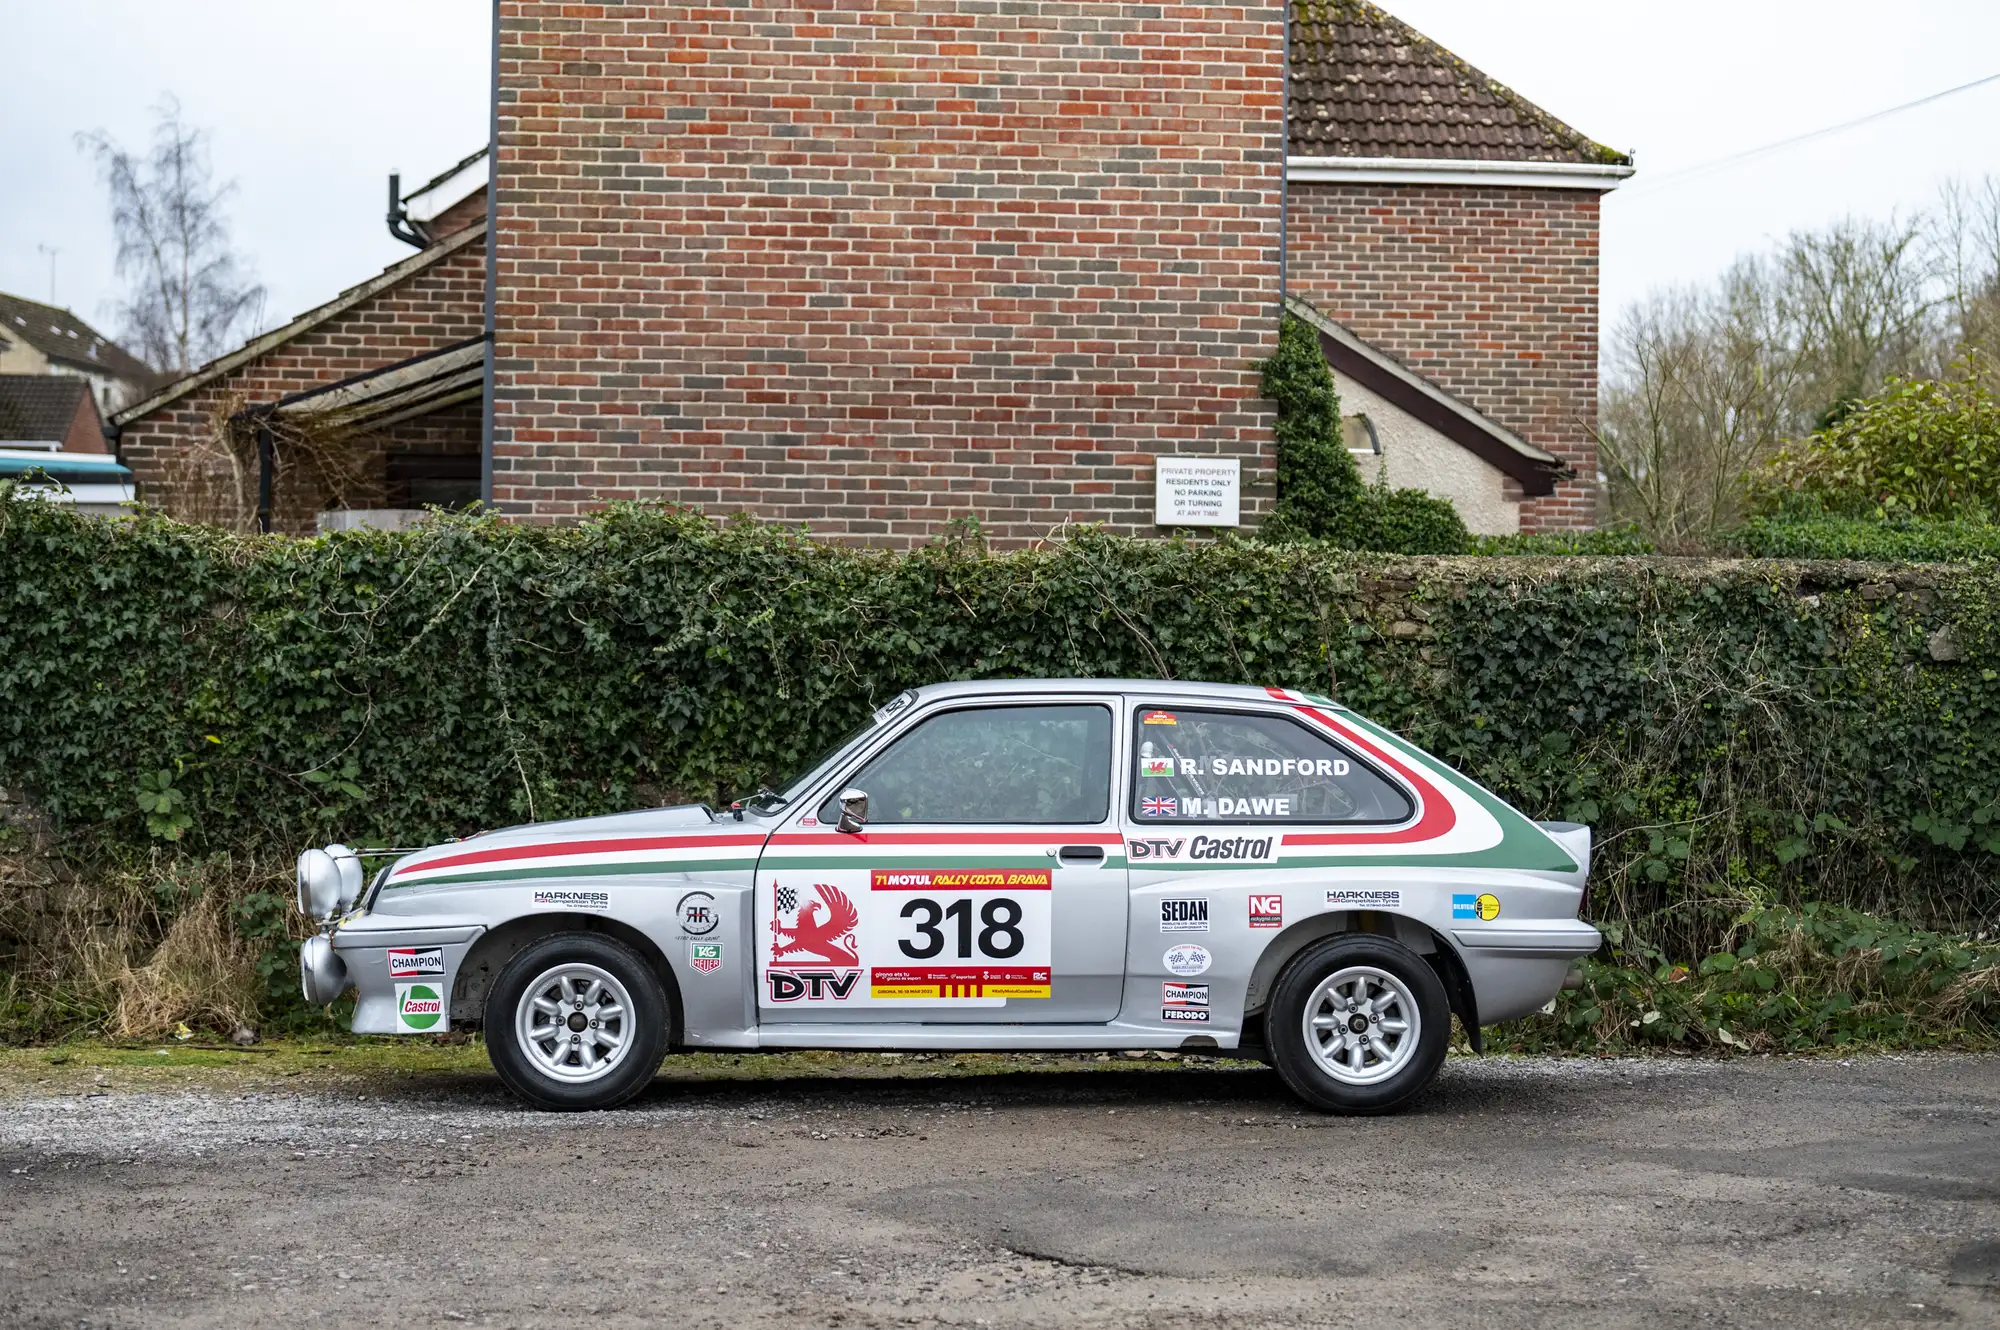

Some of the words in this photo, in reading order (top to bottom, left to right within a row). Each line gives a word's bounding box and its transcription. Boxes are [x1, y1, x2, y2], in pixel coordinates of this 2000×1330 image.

[1161, 467, 1193, 475] PRIVATE
[1194, 468, 1237, 476] PROPERTY
[1165, 478, 1209, 486] RESIDENTS
[1211, 479, 1231, 487] ONLY
[1188, 489, 1223, 497] PARKING
[1188, 499, 1222, 507] TURNING
[1180, 758, 1204, 775] R.
[1212, 758, 1350, 776] SANDFORD
[1182, 798, 1209, 816] M.
[1218, 798, 1290, 816] DAWE
[1127, 838, 1187, 860] DTV
[1189, 835, 1273, 860] Castrol
[875, 875, 888, 885] 71
[887, 875, 931, 886] MOTUL
[932, 874, 971, 885] RALLY
[969, 874, 1004, 885] COSTA
[1006, 874, 1048, 885] BRAVA
[534, 892, 608, 900] HARKNESS
[1327, 891, 1399, 899] HARKNESS
[1162, 901, 1208, 921] SEDAN
[1250, 897, 1281, 914] NG
[897, 898, 1025, 959] 318
[697, 947, 716, 957] TAG
[392, 957, 441, 968] CHAMPION
[694, 960, 719, 971] HEUER
[766, 969, 864, 1002] DTV
[1165, 990, 1207, 1000] CHAMPION
[405, 1001, 440, 1012] Castrol
[1165, 1010, 1206, 1020] FERODO
